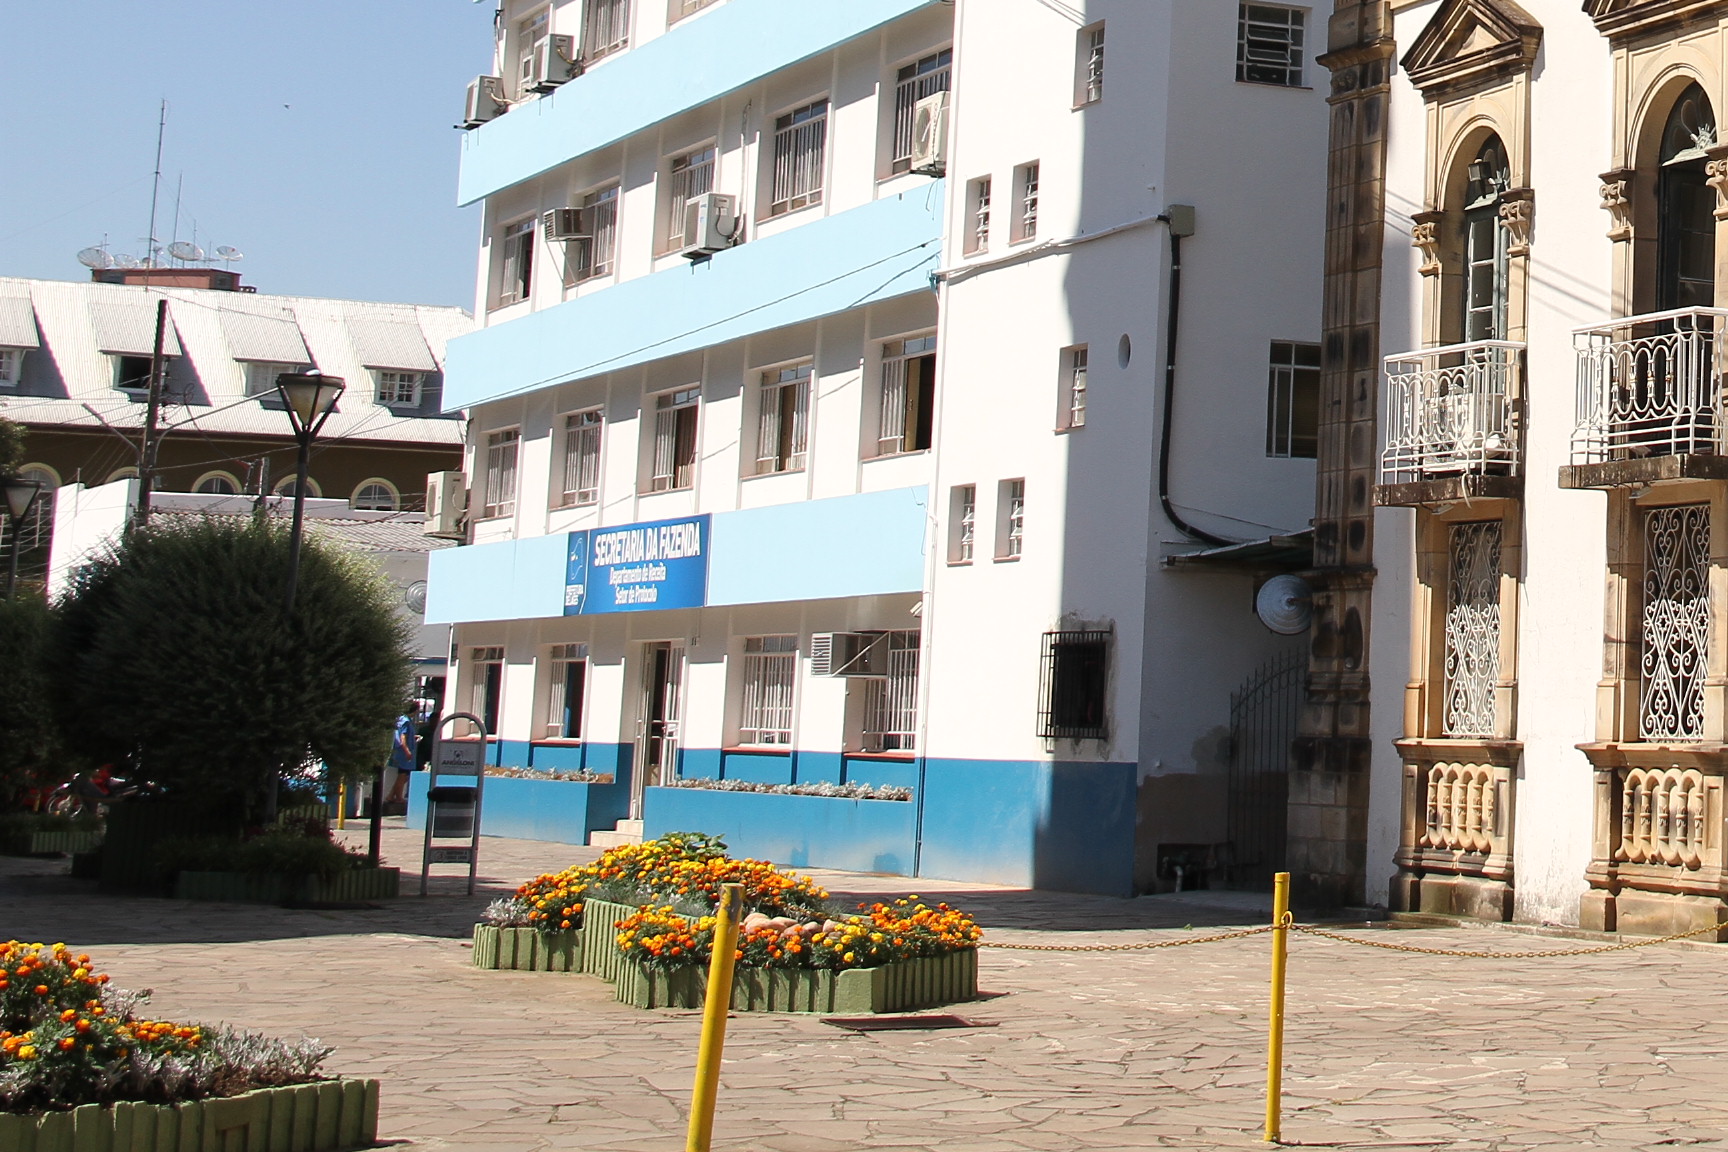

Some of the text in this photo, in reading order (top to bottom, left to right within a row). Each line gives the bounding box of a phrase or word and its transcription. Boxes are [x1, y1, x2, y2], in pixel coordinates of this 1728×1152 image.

[595, 522, 700, 566] SECRETARIA DA FAZENDA
[609, 565, 642, 588] Departamento
[642, 563, 648, 582] de
[615, 584, 657, 605] Setor de Protocolo
